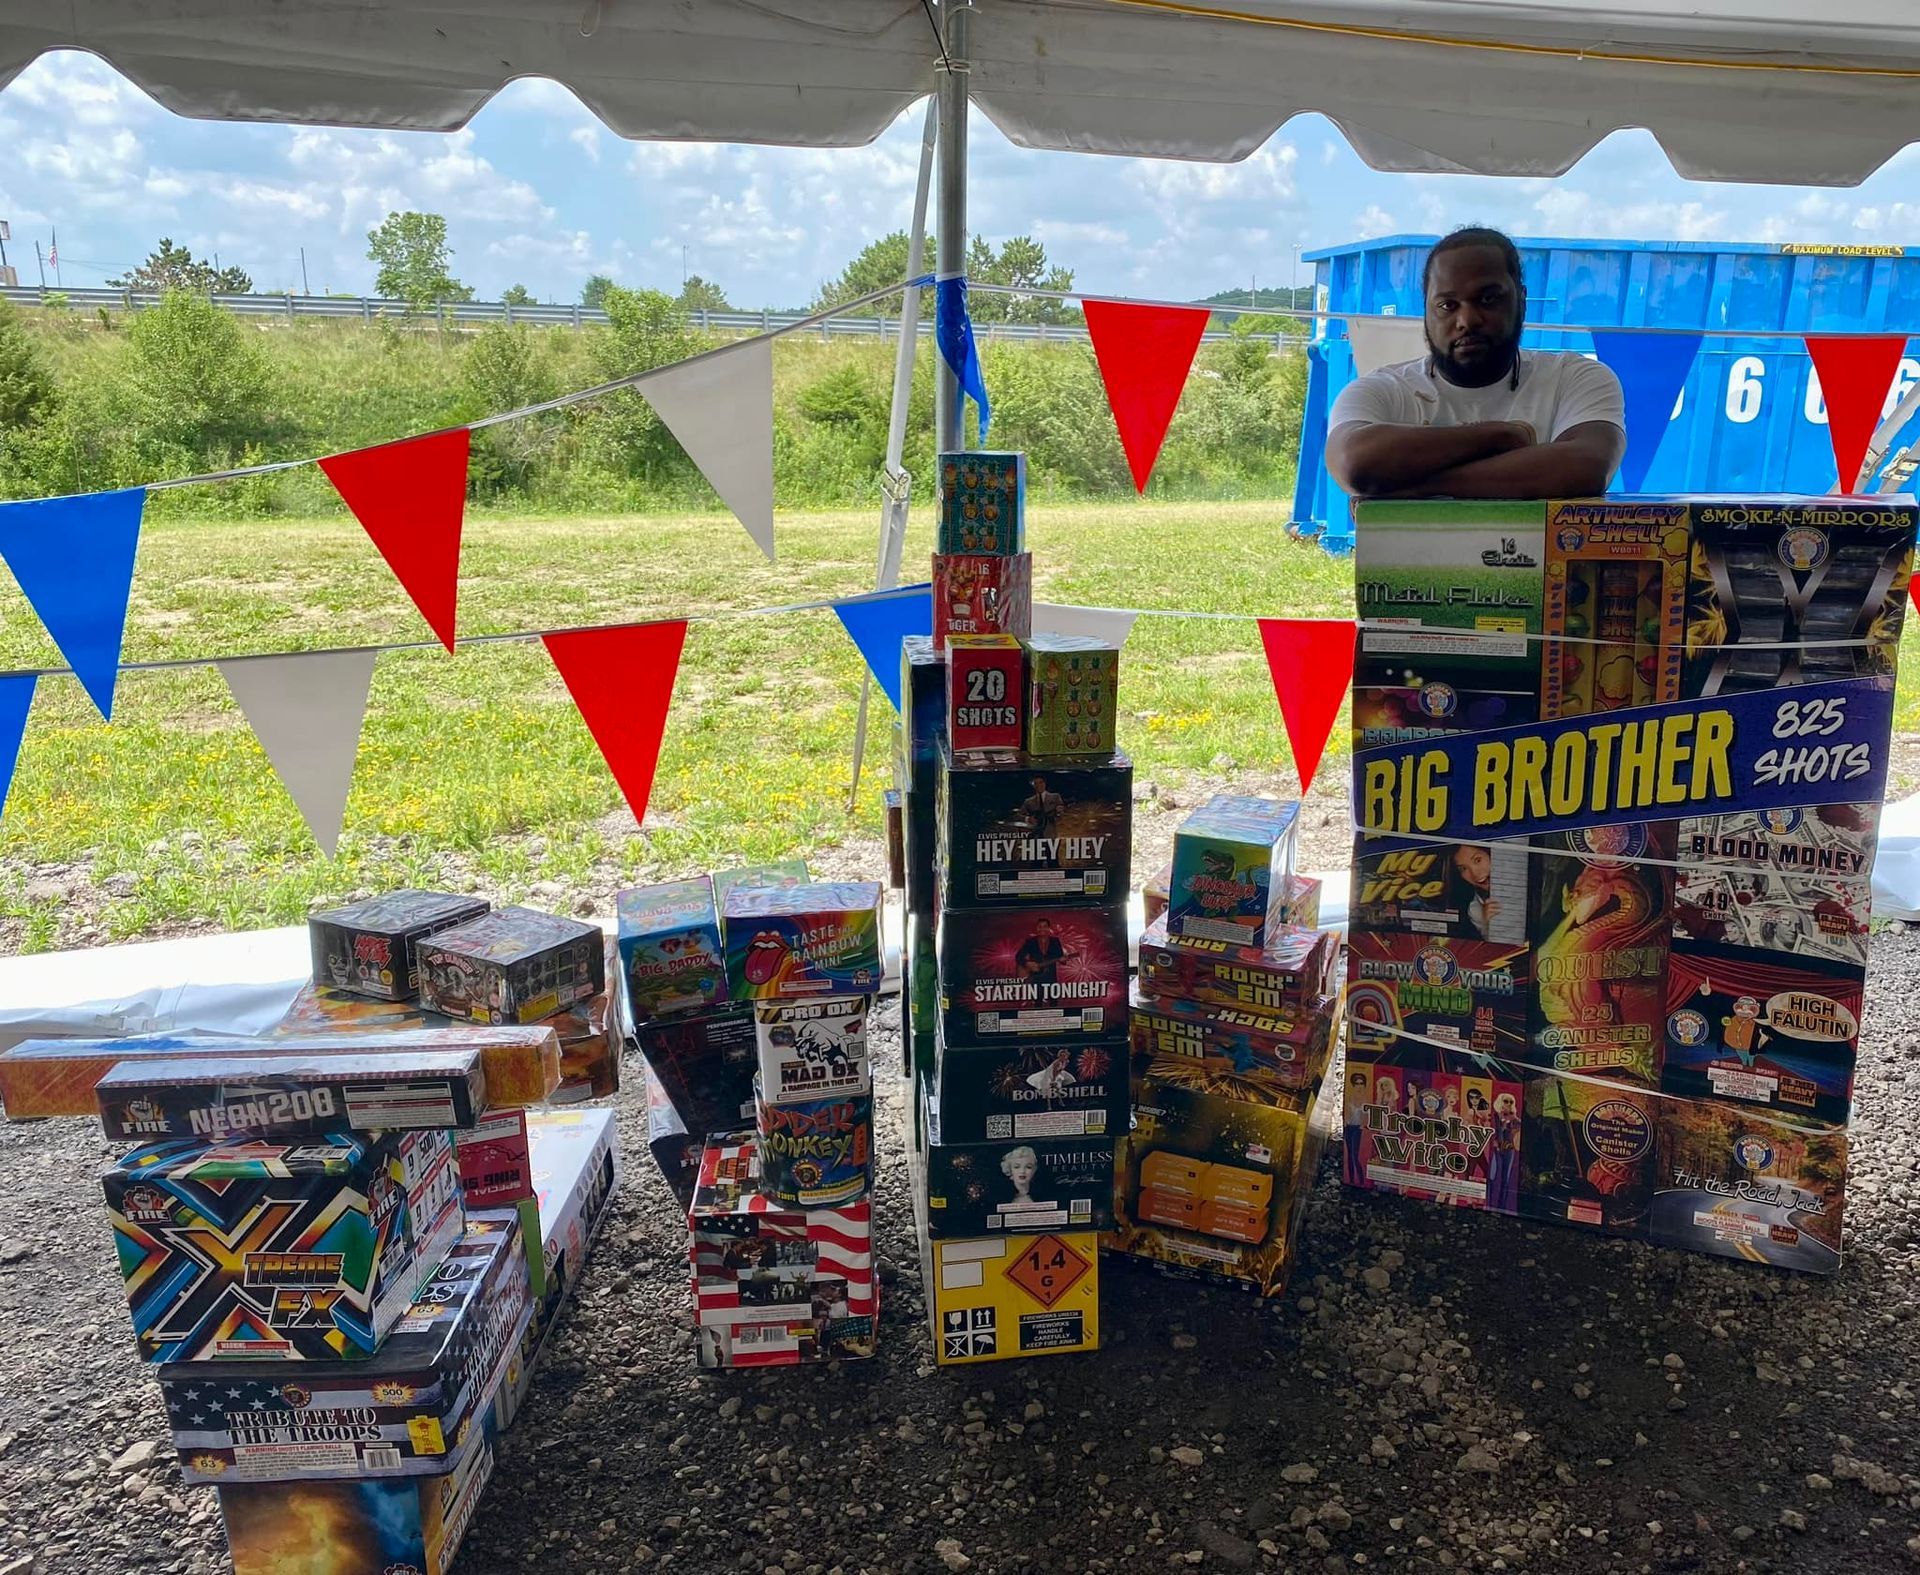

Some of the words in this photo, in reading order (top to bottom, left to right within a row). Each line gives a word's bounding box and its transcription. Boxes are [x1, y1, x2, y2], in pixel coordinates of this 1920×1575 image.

[1793, 245, 1834, 255] MAXIMUM
[1838, 247, 1862, 255] LOAD
[1866, 247, 1893, 256] LEVEL
[1554, 505, 1686, 525] ARTILLERY
[1701, 509, 1911, 527] SMOKE-N-MIRRORS
[1588, 524, 1664, 543] SHELL
[1501, 538, 1516, 553] 16
[978, 563, 989, 575] 16
[1360, 582, 1440, 604] Metal
[1449, 586, 1534, 607] Flake
[966, 670, 1005, 701] 20
[957, 707, 1016, 726] SHOTS
[1772, 698, 1846, 738] 825
[1753, 743, 1870, 785] SHOTS
[1365, 750, 1450, 841] BIG
[1473, 710, 1734, 826] BROTHER
[976, 840, 1016, 862] HEY
[1021, 838, 1061, 860] HEY
[1065, 837, 1105, 859] HEY
[1691, 833, 1769, 861] BLOOD
[1779, 843, 1865, 873] MONEY
[1376, 851, 1438, 876] My
[1360, 879, 1446, 904] Vice
[1703, 889, 1728, 910] 49
[791, 925, 835, 948] TASTE
[428, 953, 443, 966] TOP
[792, 934, 863, 964] RAINBOW
[639, 964, 663, 977] BIG
[668, 952, 713, 974] DADDY
[815, 957, 841, 971] MINI
[1537, 947, 1667, 984] QUEST
[1360, 960, 1414, 982] BLOW
[1459, 971, 1514, 994] YOUR
[974, 984, 1038, 1003] STARTIN
[1041, 981, 1109, 1000] TONIGHT
[1237, 984, 1282, 1008] EM
[1399, 982, 1472, 1015] MIND
[781, 1006, 823, 1021] PRO
[827, 1002, 853, 1014] OX
[1475, 1007, 1494, 1020] 44
[1582, 1004, 1612, 1022] 24
[1789, 996, 1836, 1018] HIGH
[1772, 1010, 1849, 1038] FALUTIN
[1157, 1032, 1207, 1059] EM
[1543, 1025, 1651, 1048] CANISTER
[1554, 1049, 1635, 1070] SHELLS
[781, 1066, 827, 1085] MAD
[832, 1061, 860, 1078] OX
[1012, 1085, 1107, 1101] BOMBSHELL
[1781, 1084, 1814, 1096] HEAVY
[122, 1121, 172, 1134] FIRE
[1364, 1104, 1495, 1157] Trophy
[1591, 1123, 1620, 1131] Original
[1621, 1127, 1644, 1135] Maker
[762, 1132, 852, 1171] MONKEY
[1596, 1136, 1638, 1148] Canister
[1601, 1144, 1631, 1156] Shells
[1041, 1151, 1113, 1165] TIMELESS
[1373, 1135, 1468, 1173] Wife
[1052, 1163, 1106, 1172] BEAUTY
[473, 1181, 522, 1196] SPECIAL
[1672, 1167, 1701, 1189] Hit
[1704, 1174, 1734, 1196] the
[1734, 1180, 1782, 1208] Road,
[1784, 1189, 1826, 1216] Jack
[126, 1210, 170, 1222] FIRE
[1029, 1249, 1065, 1271] 1.4
[1041, 1276, 1053, 1287] G
[269, 1288, 345, 1328] FX
[1032, 1321, 1070, 1329] FIREWORKS
[1033, 1333, 1071, 1341] CAREFULLY
[382, 1388, 403, 1396] 500
[224, 1409, 339, 1428] TRIBUTE
[341, 1407, 377, 1426] TO
[226, 1427, 279, 1445] THE
[284, 1425, 383, 1443] TROOPS
[422, 1429, 434, 1448] FUSE
[245, 1446, 277, 1454] WARNING
[200, 1459, 217, 1468] 63
